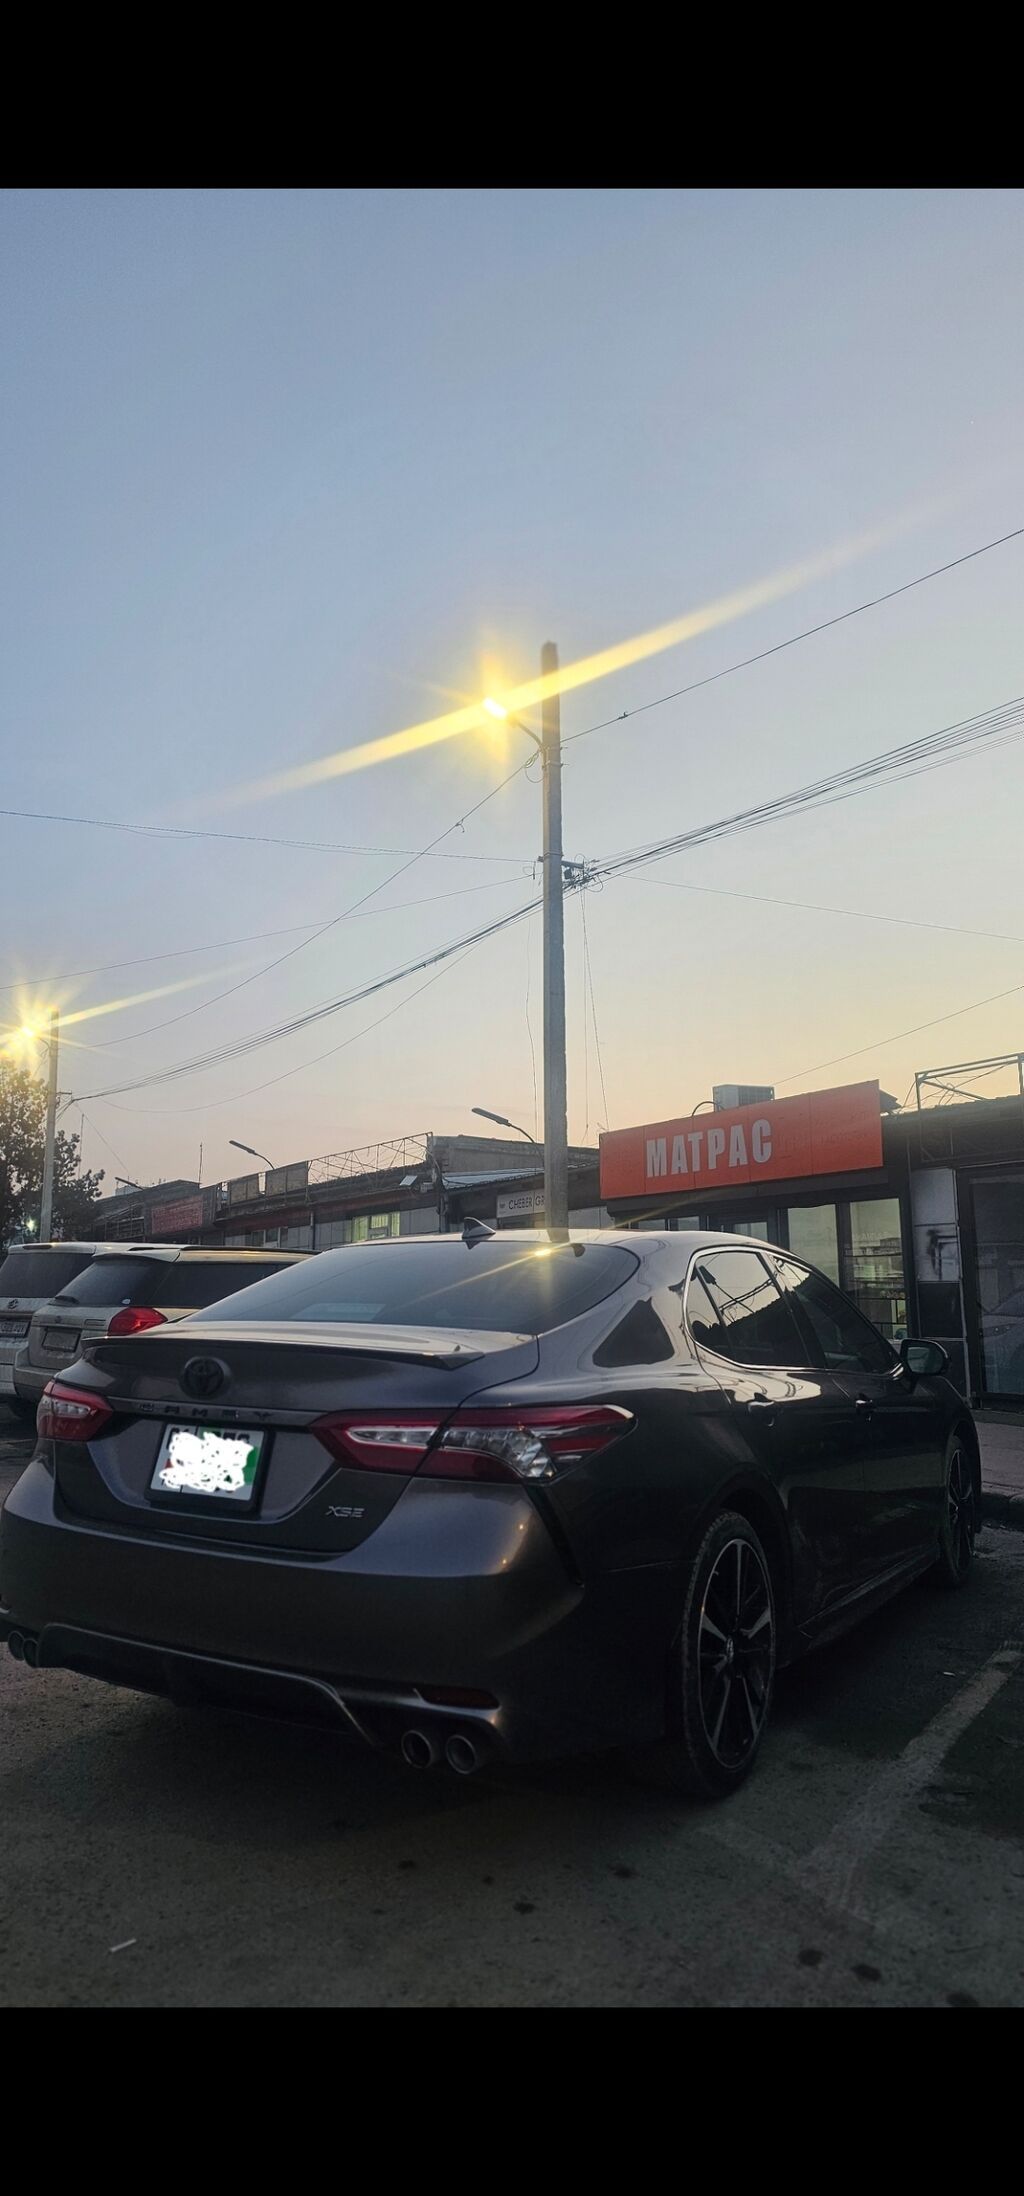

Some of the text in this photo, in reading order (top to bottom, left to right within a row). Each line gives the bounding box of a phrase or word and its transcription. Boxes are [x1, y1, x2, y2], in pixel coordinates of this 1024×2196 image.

[646, 1119, 773, 1178] МАТРАС
[138, 1402, 273, 1421] CAMRY
[324, 1505, 366, 1518] XSE
